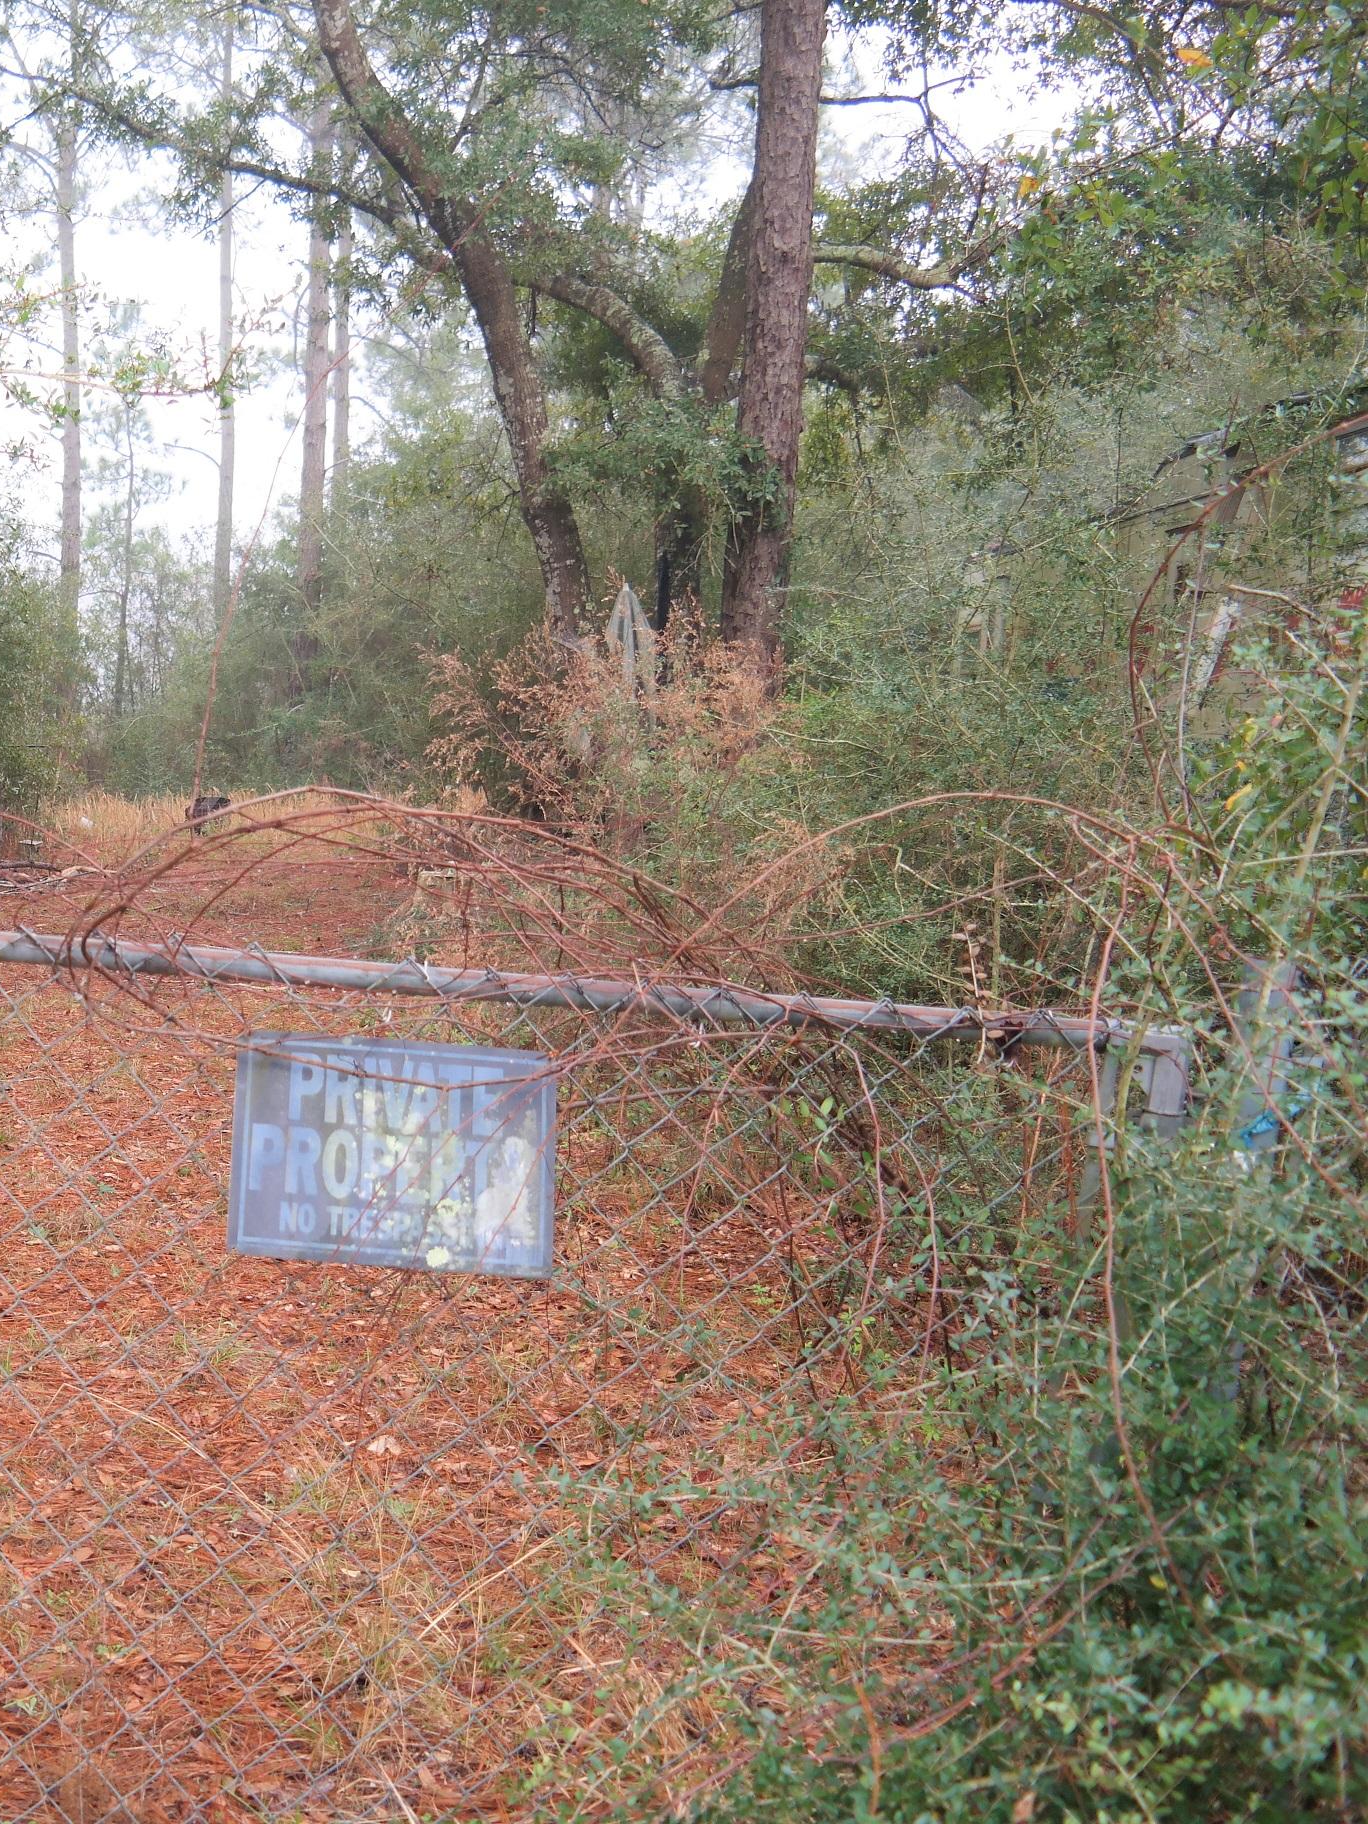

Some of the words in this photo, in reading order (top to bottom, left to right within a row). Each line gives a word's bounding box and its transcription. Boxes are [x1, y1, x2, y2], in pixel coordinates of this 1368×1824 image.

[288, 1051, 504, 1137] PRIVATE
[248, 1122, 536, 1204] PROPERT
[279, 1201, 317, 1234] NO
